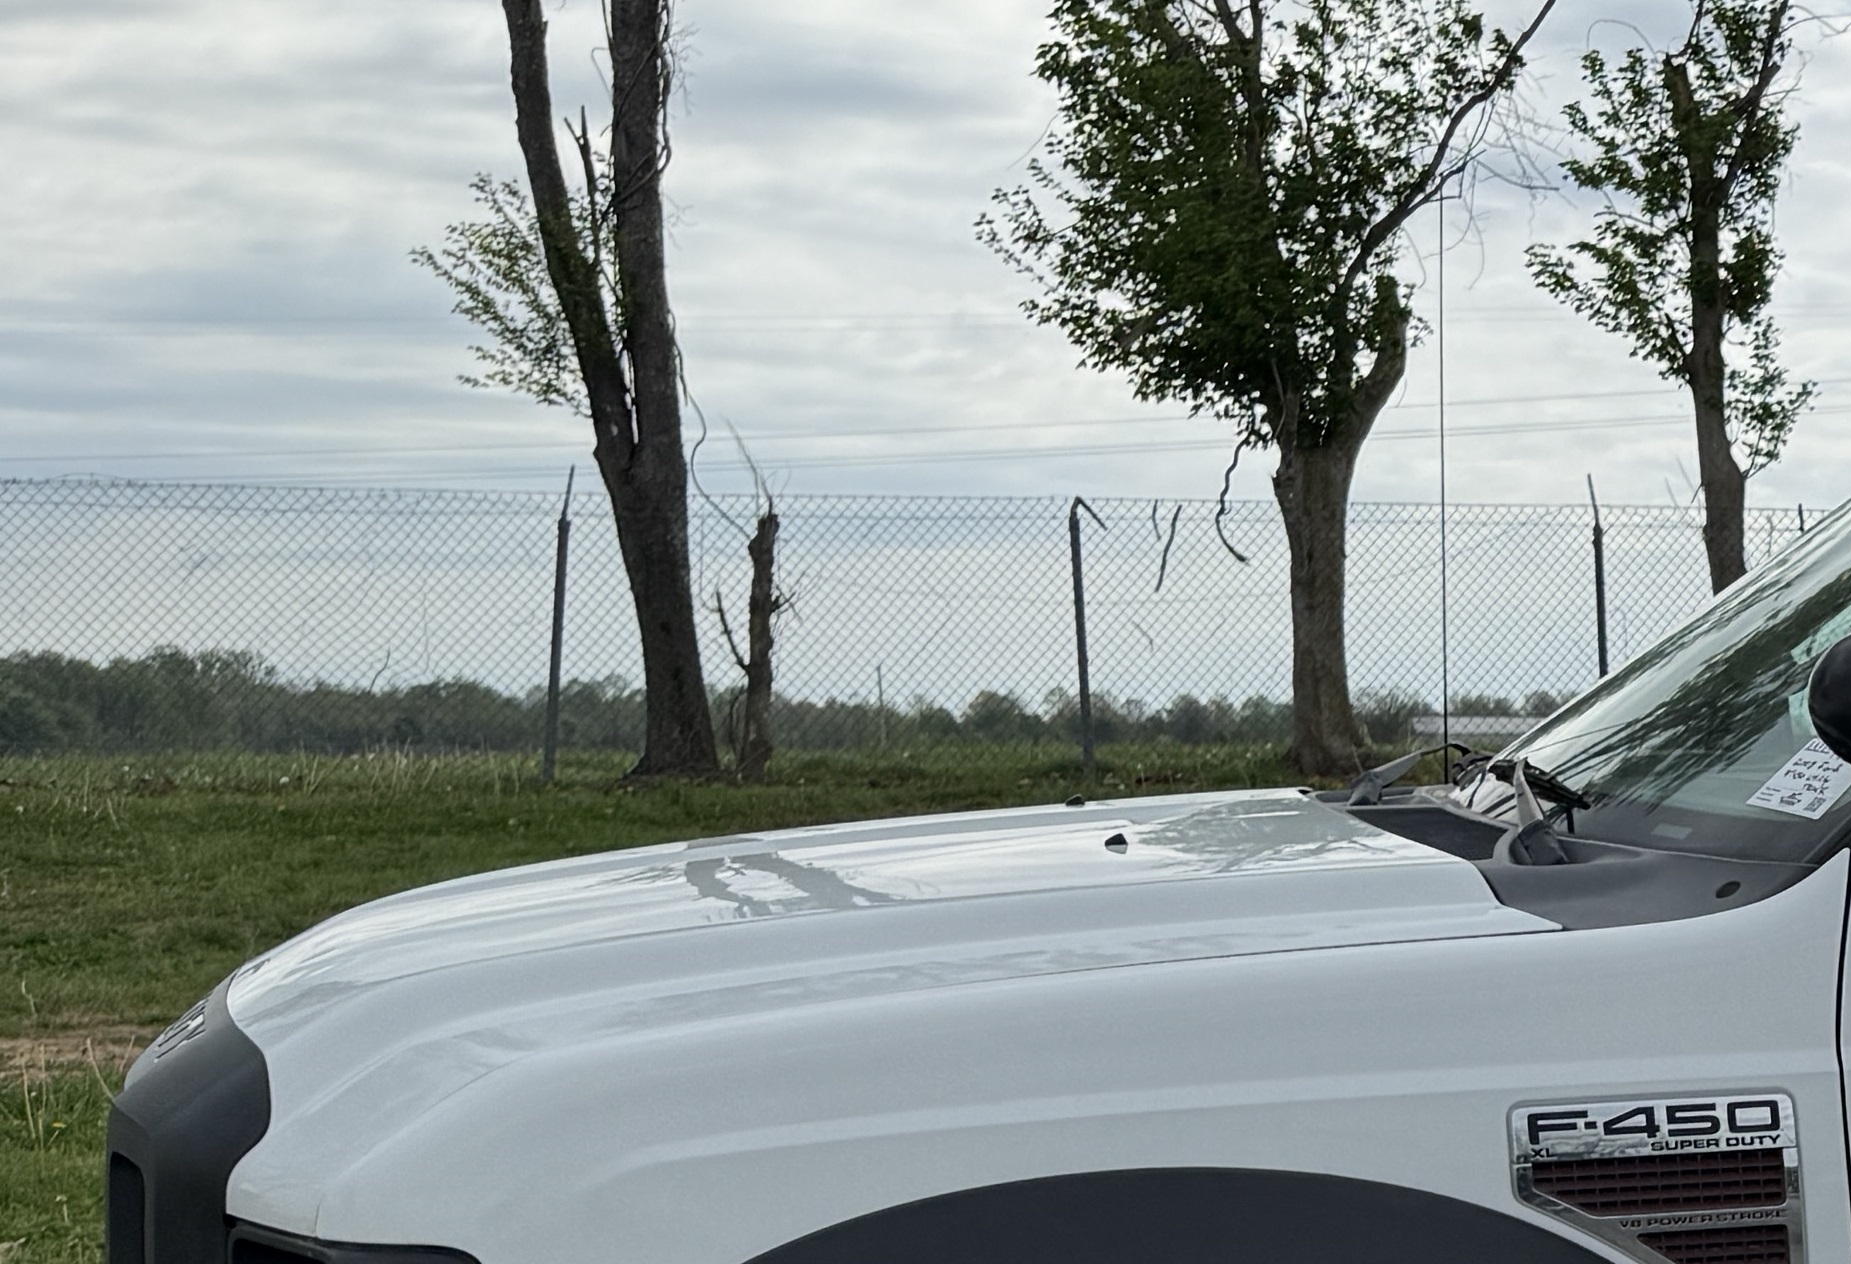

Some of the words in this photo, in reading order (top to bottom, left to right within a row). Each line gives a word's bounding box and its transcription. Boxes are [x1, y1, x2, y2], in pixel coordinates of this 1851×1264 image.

[1527, 1100, 1781, 1146] F-450
[1650, 1138, 1719, 1152] SUPER
[1725, 1134, 1782, 1147] DUTY
[1531, 1147, 1556, 1159] XL
[1647, 1213, 1713, 1227] POWER
[1716, 1209, 1788, 1222] STROKE
